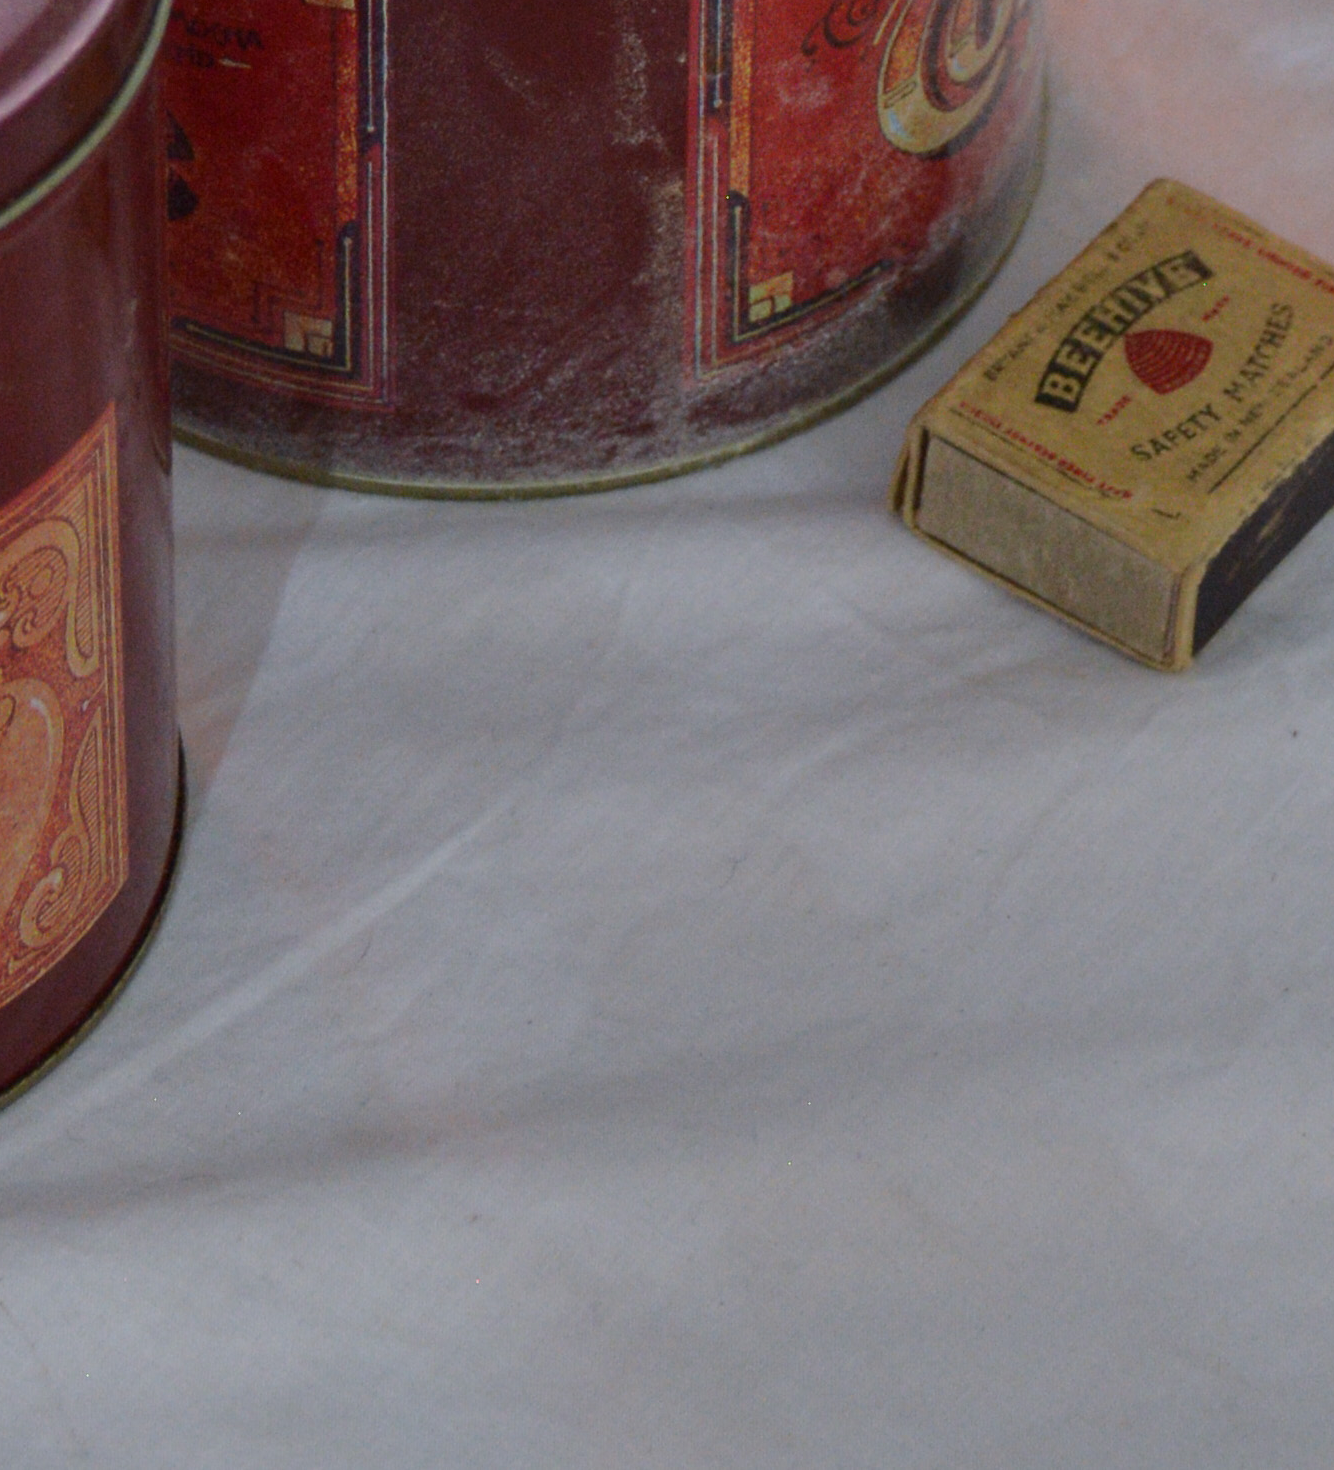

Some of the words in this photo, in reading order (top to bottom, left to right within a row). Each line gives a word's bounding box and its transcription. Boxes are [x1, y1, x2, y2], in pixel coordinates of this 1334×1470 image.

[1039, 253, 1203, 404] BEEHIVE
[1130, 403, 1221, 460] SAFETY
[1223, 302, 1294, 403] MATCHES
